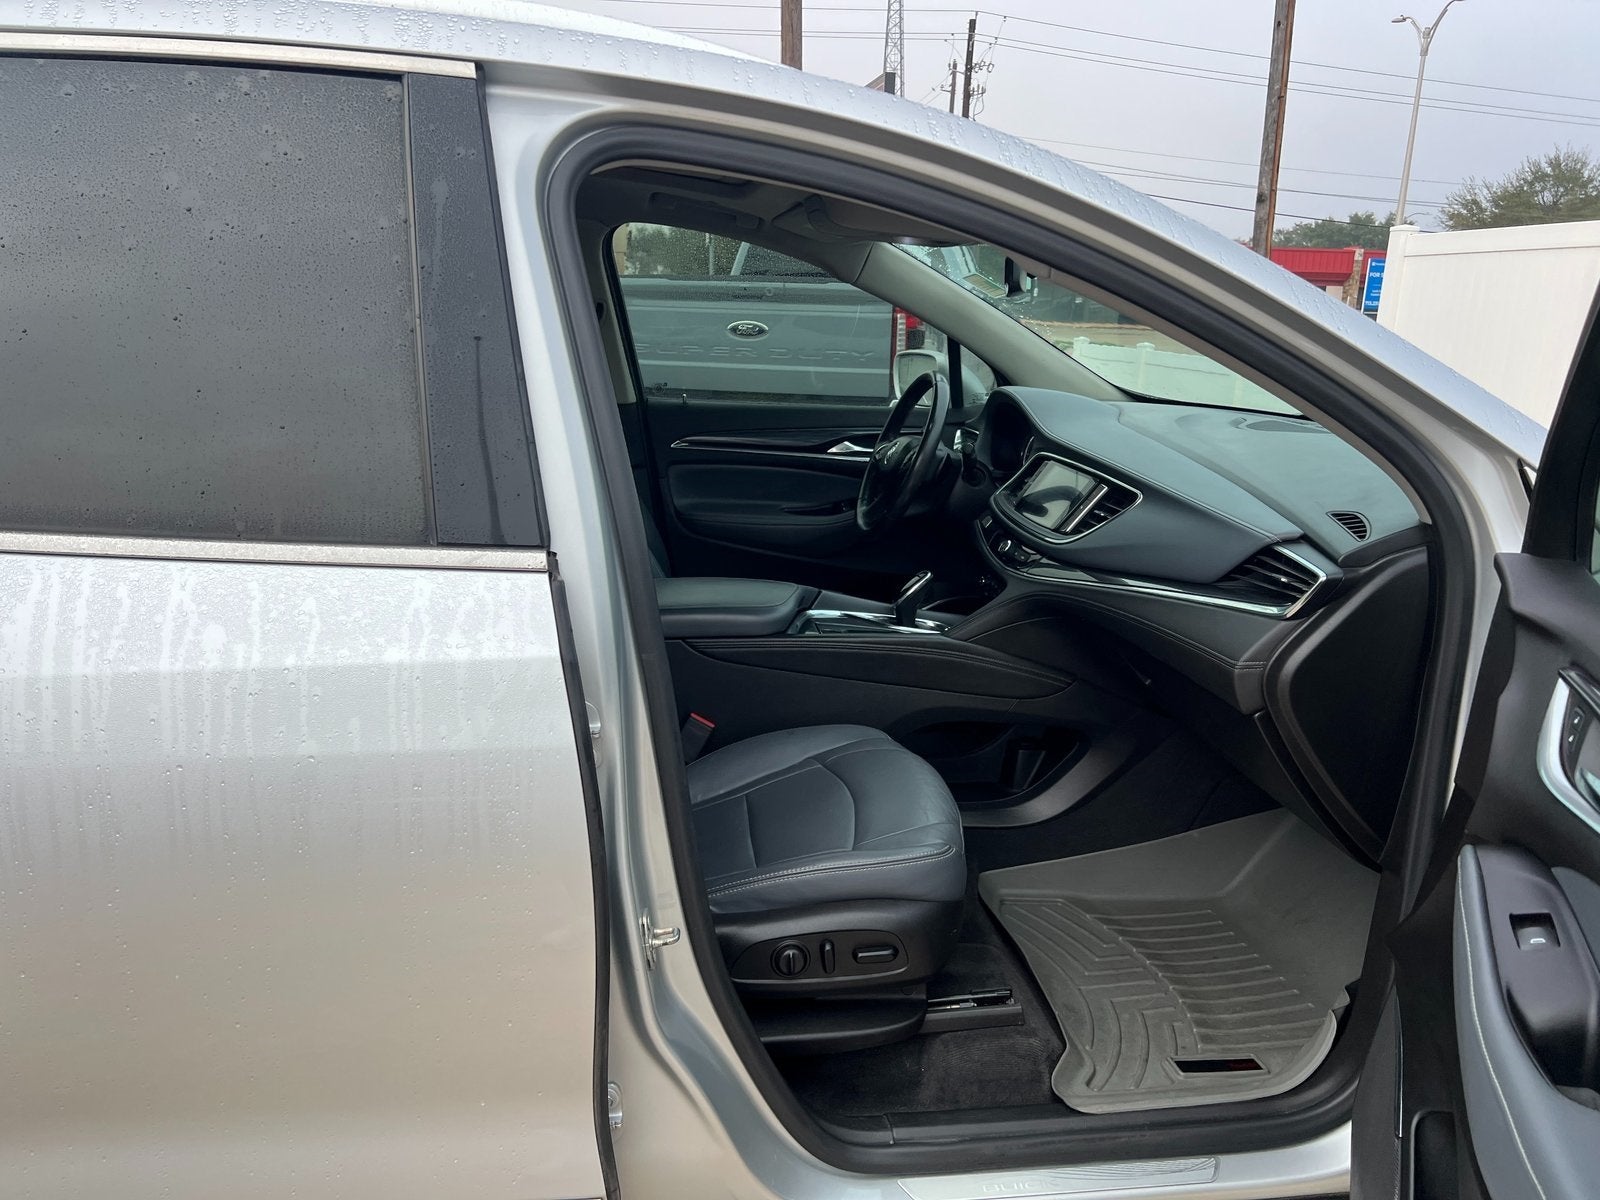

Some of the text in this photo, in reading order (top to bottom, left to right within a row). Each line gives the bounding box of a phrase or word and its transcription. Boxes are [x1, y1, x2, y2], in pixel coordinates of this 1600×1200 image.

[736, 324, 760, 335] Ford
[769, 348, 874, 362] DUTY
[982, 1179, 1060, 1193] BUICK
